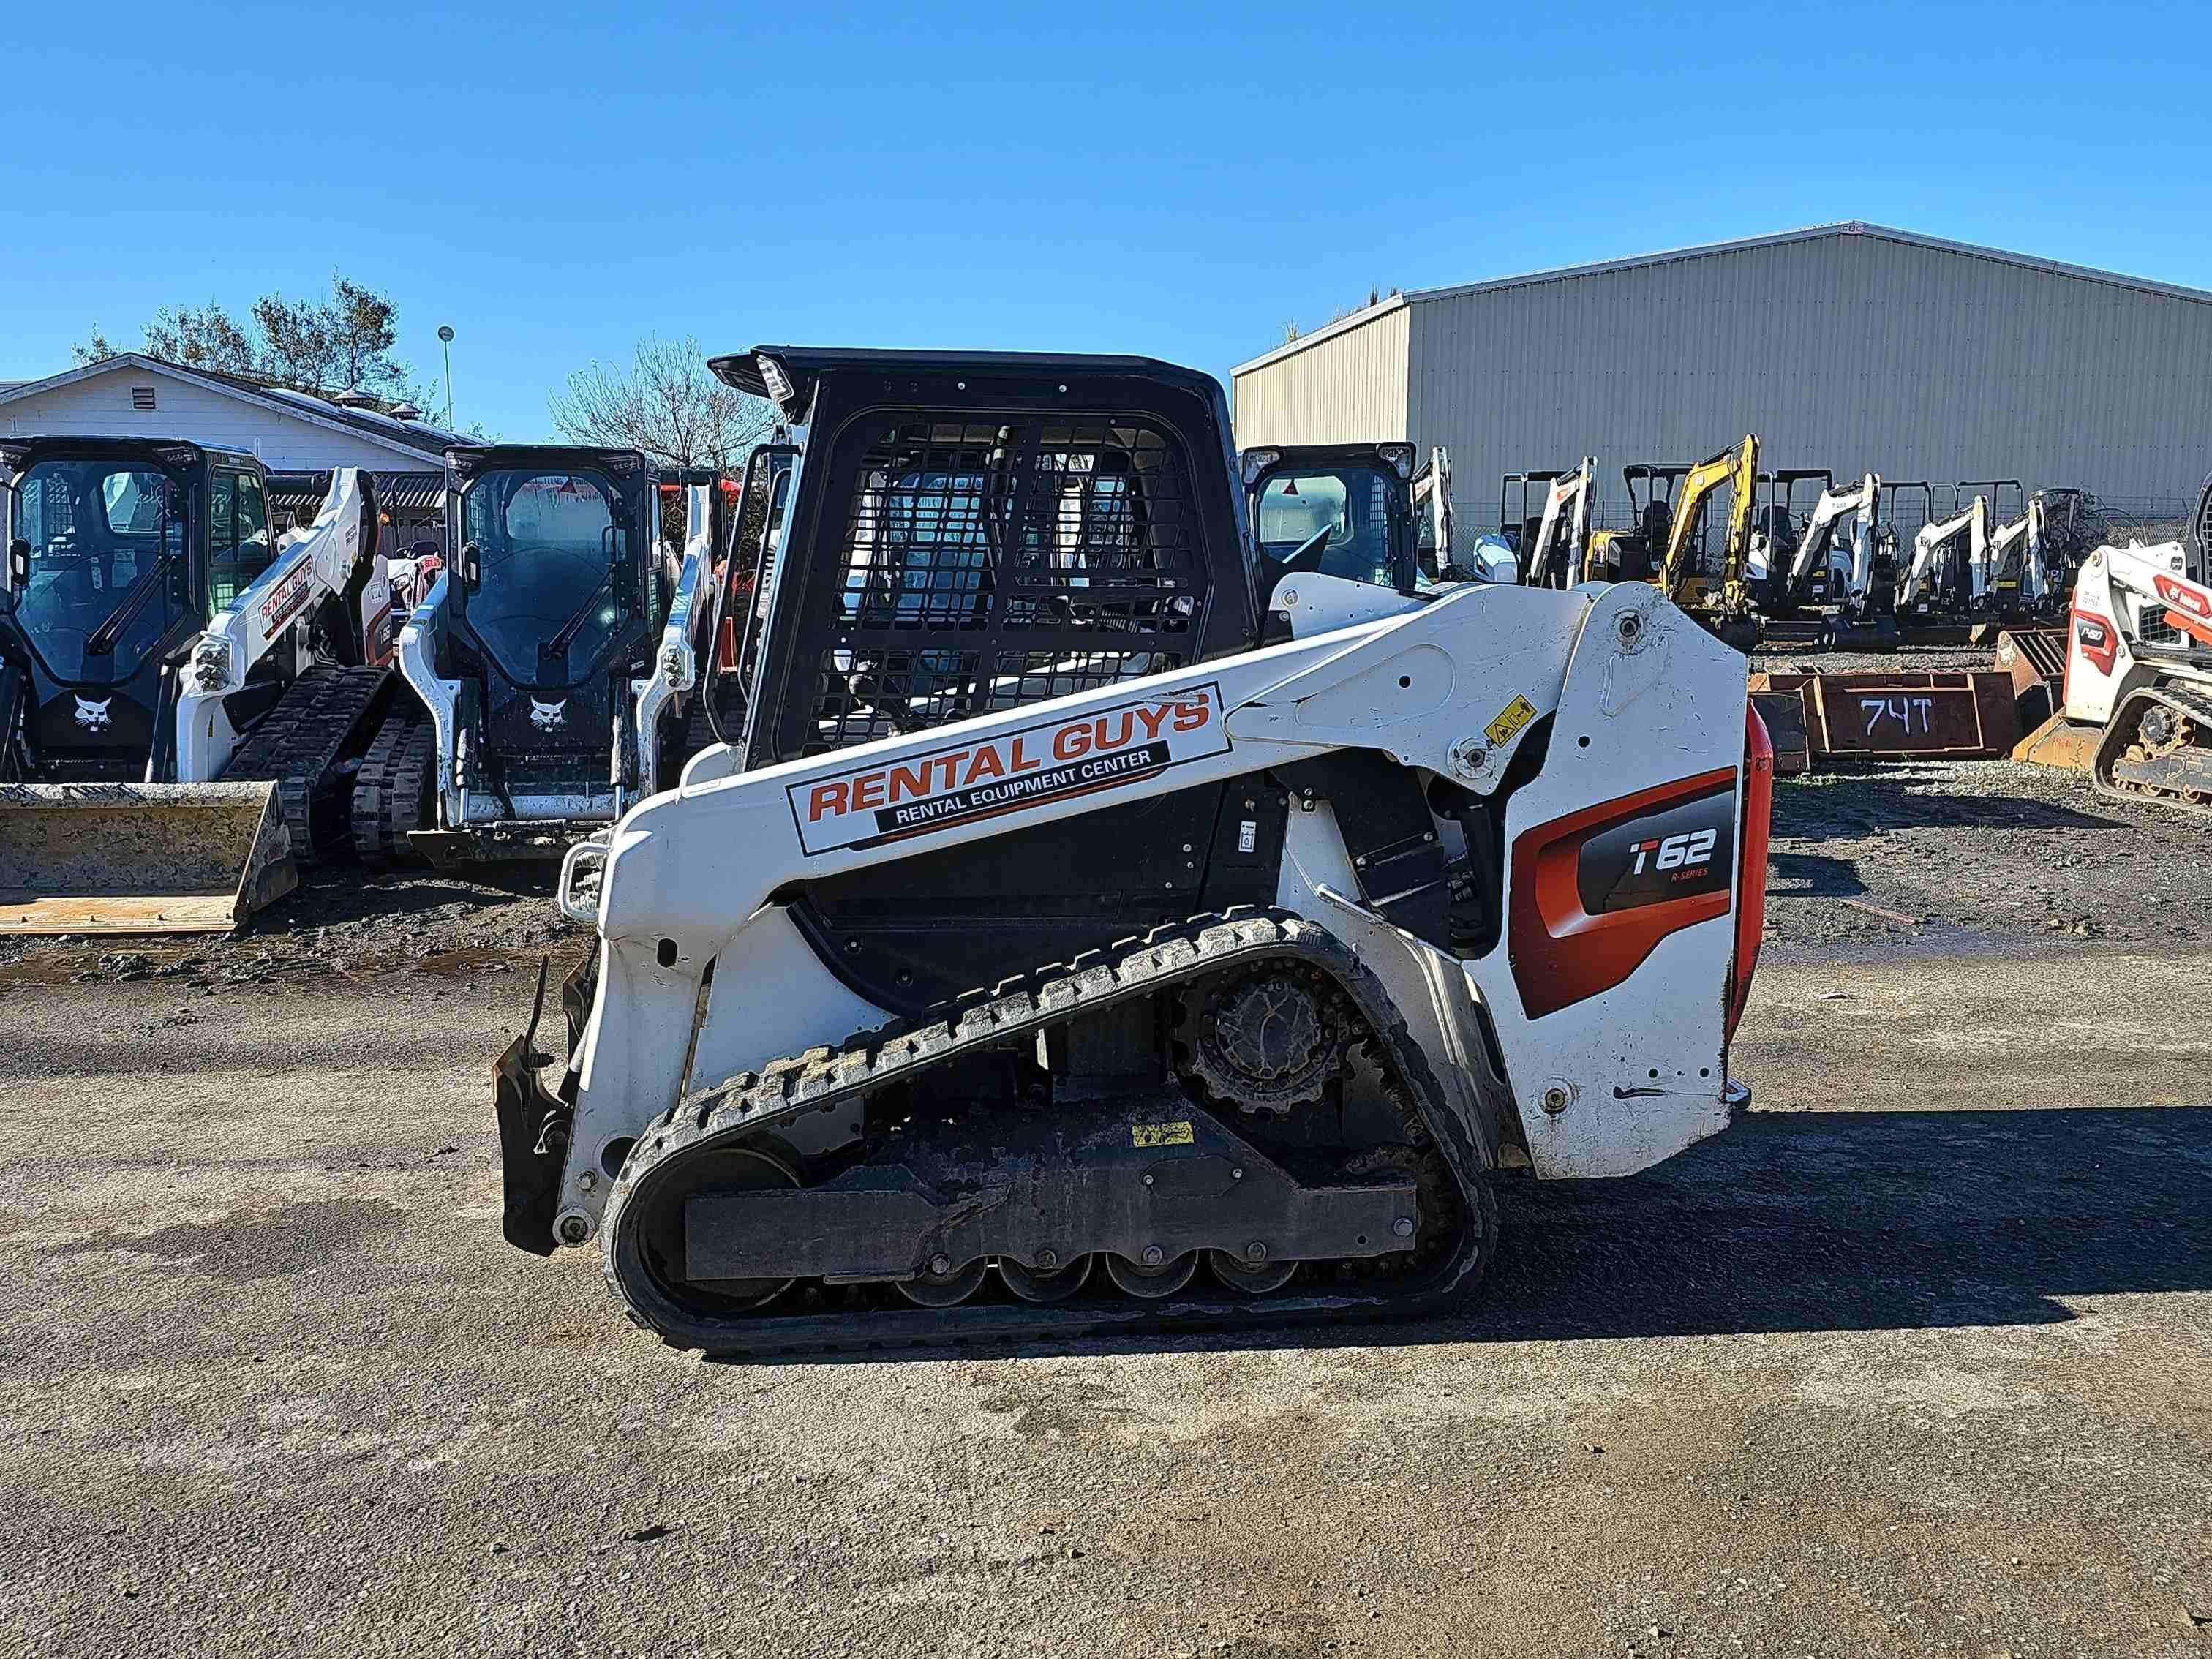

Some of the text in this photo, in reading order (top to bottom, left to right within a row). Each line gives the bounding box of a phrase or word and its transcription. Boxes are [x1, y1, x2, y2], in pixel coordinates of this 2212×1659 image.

[261, 582, 291, 621] RENTAL
[293, 561, 313, 590] GUYS
[1860, 696, 1932, 736] 74T
[808, 693, 1211, 822] RENTAL GUYS
[895, 750, 1152, 824] RENTAL EQUIPMENT CENTER
[1629, 828, 1718, 875] T62
[1670, 868, 1709, 882] R-SERIES
